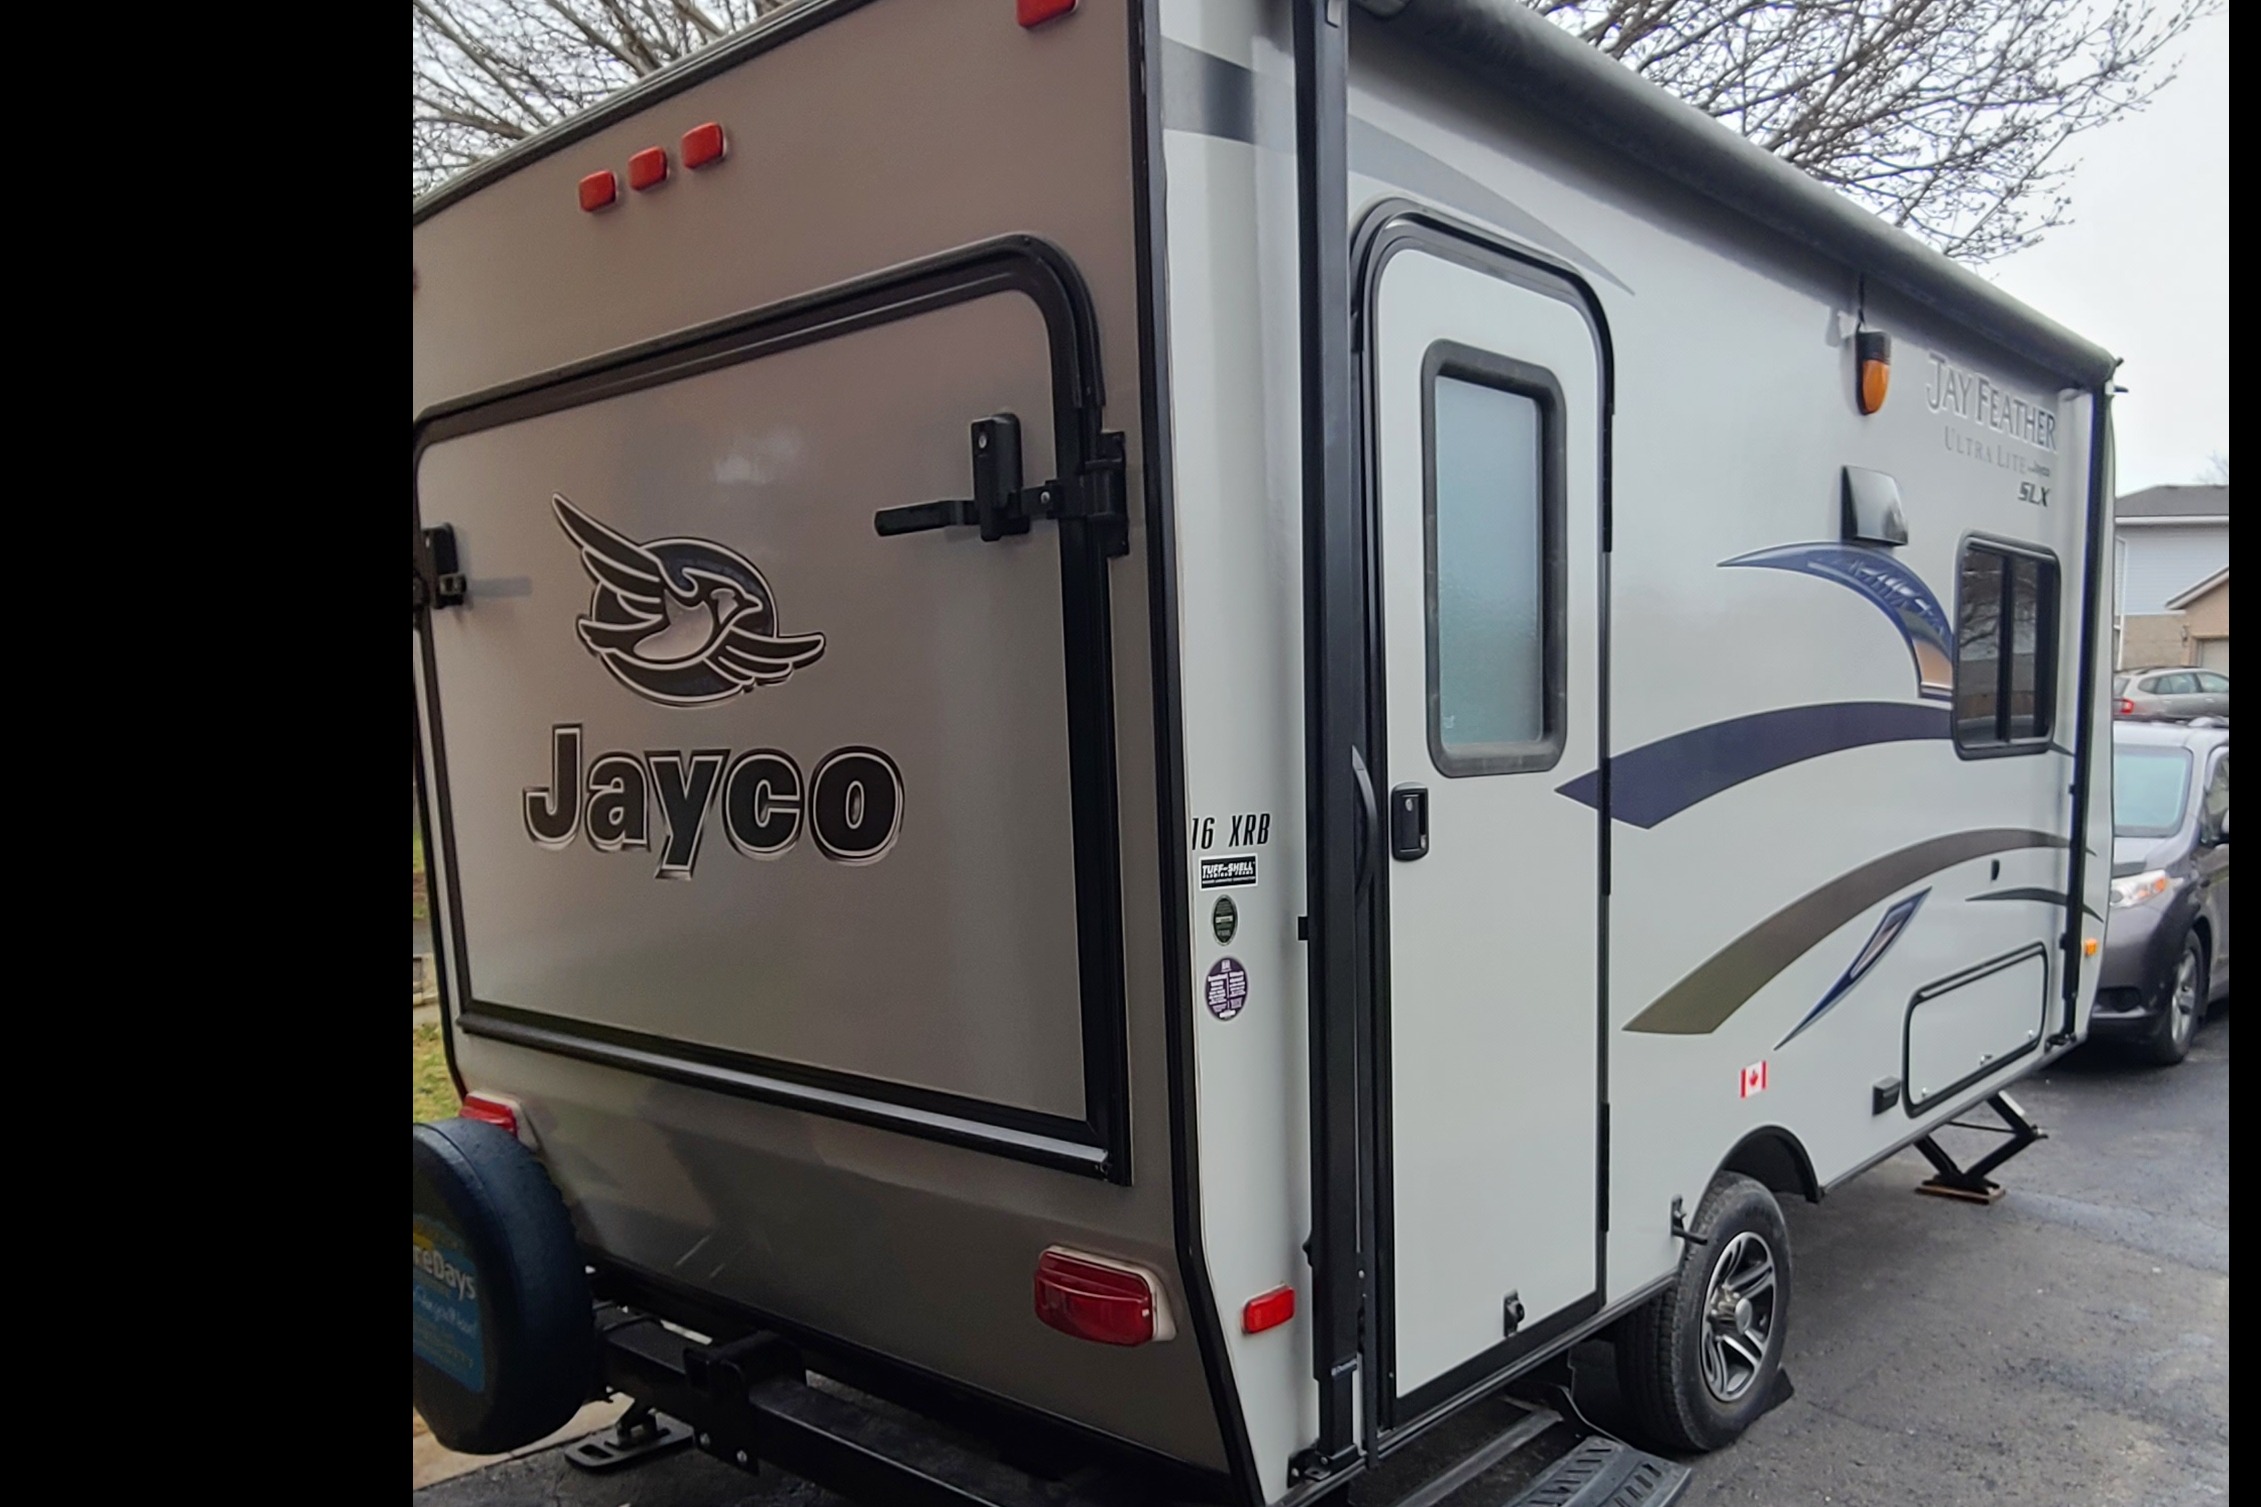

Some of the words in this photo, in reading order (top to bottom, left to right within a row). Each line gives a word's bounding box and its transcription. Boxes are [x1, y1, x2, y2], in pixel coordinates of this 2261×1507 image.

[1926, 352, 1973, 416] JAY
[1976, 375, 2057, 452] FEATHER
[1944, 425, 1992, 464] ULTRA
[1997, 444, 2026, 475] LITE
[2017, 481, 2051, 508] SLX
[523, 723, 904, 880] Jayco
[1192, 817, 1215, 850] 16
[1228, 813, 1270, 847] XRB
[1202, 861, 1254, 876] TUFF-SHELL
[413, 1245, 476, 1301] reDays
